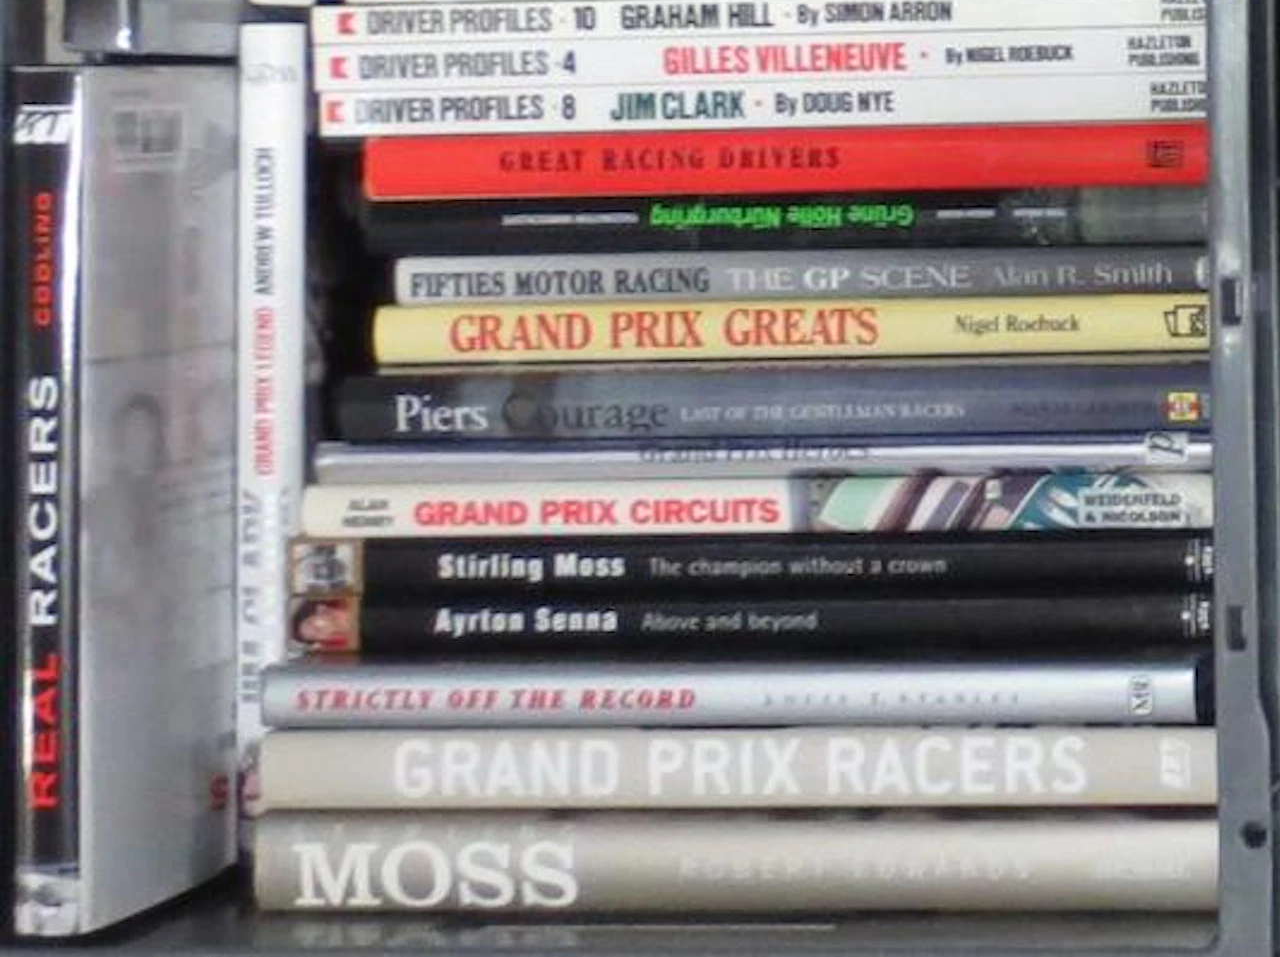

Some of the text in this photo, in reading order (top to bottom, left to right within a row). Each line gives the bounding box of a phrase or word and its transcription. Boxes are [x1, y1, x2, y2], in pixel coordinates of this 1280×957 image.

[367, 1, 952, 34] DRIVER PROFILES 10 GRAHAM HILL By SIMON ARRON
[663, 43, 906, 74] GILLES VILLENEUVE
[451, 308, 878, 353] GRAND PRIX GREATS
[28, 192, 61, 810] REAL RACERS CODLING
[415, 498, 779, 526] GRAND PRIX CIRCUITS
[438, 555, 625, 583] Stirling Moss
[434, 608, 618, 634] Ayrton Senna
[393, 736, 1089, 799] GRAND PRIX RACERS
[293, 840, 578, 908] MOSS
